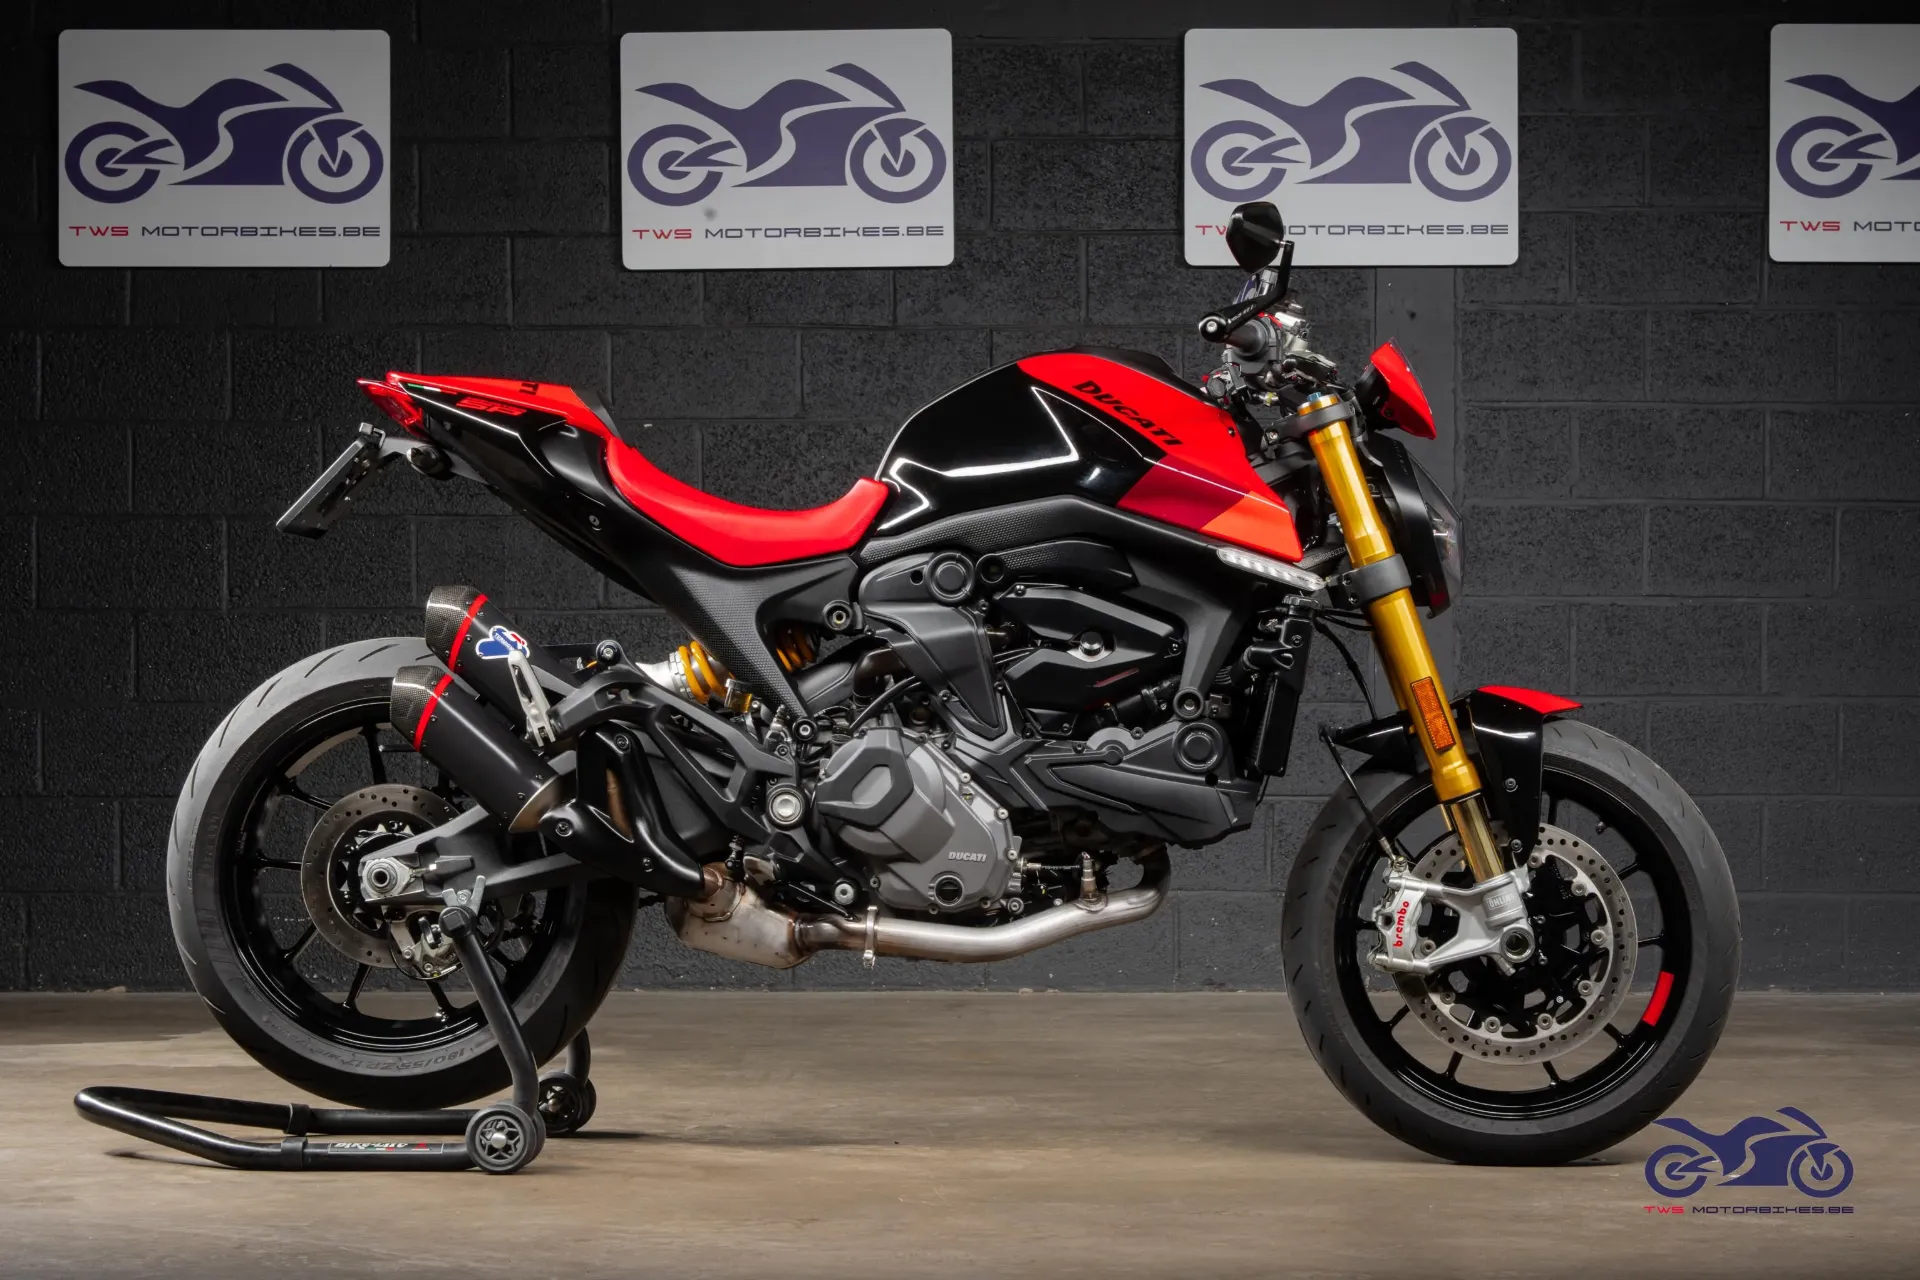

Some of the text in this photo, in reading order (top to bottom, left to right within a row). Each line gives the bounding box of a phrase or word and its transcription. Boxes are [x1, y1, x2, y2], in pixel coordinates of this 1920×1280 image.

[68, 226, 381, 237] TWS MOTORBIKES.BE
[632, 225, 944, 240] TWS MOTORBIKES.BE
[1283, 224, 1509, 236] OTORBIKES.BE
[1779, 220, 1840, 232] TWS
[455, 396, 528, 417] SP
[1071, 379, 1184, 446] DUCATI
[948, 851, 987, 862] DUCATI
[1393, 901, 1410, 948] brembo
